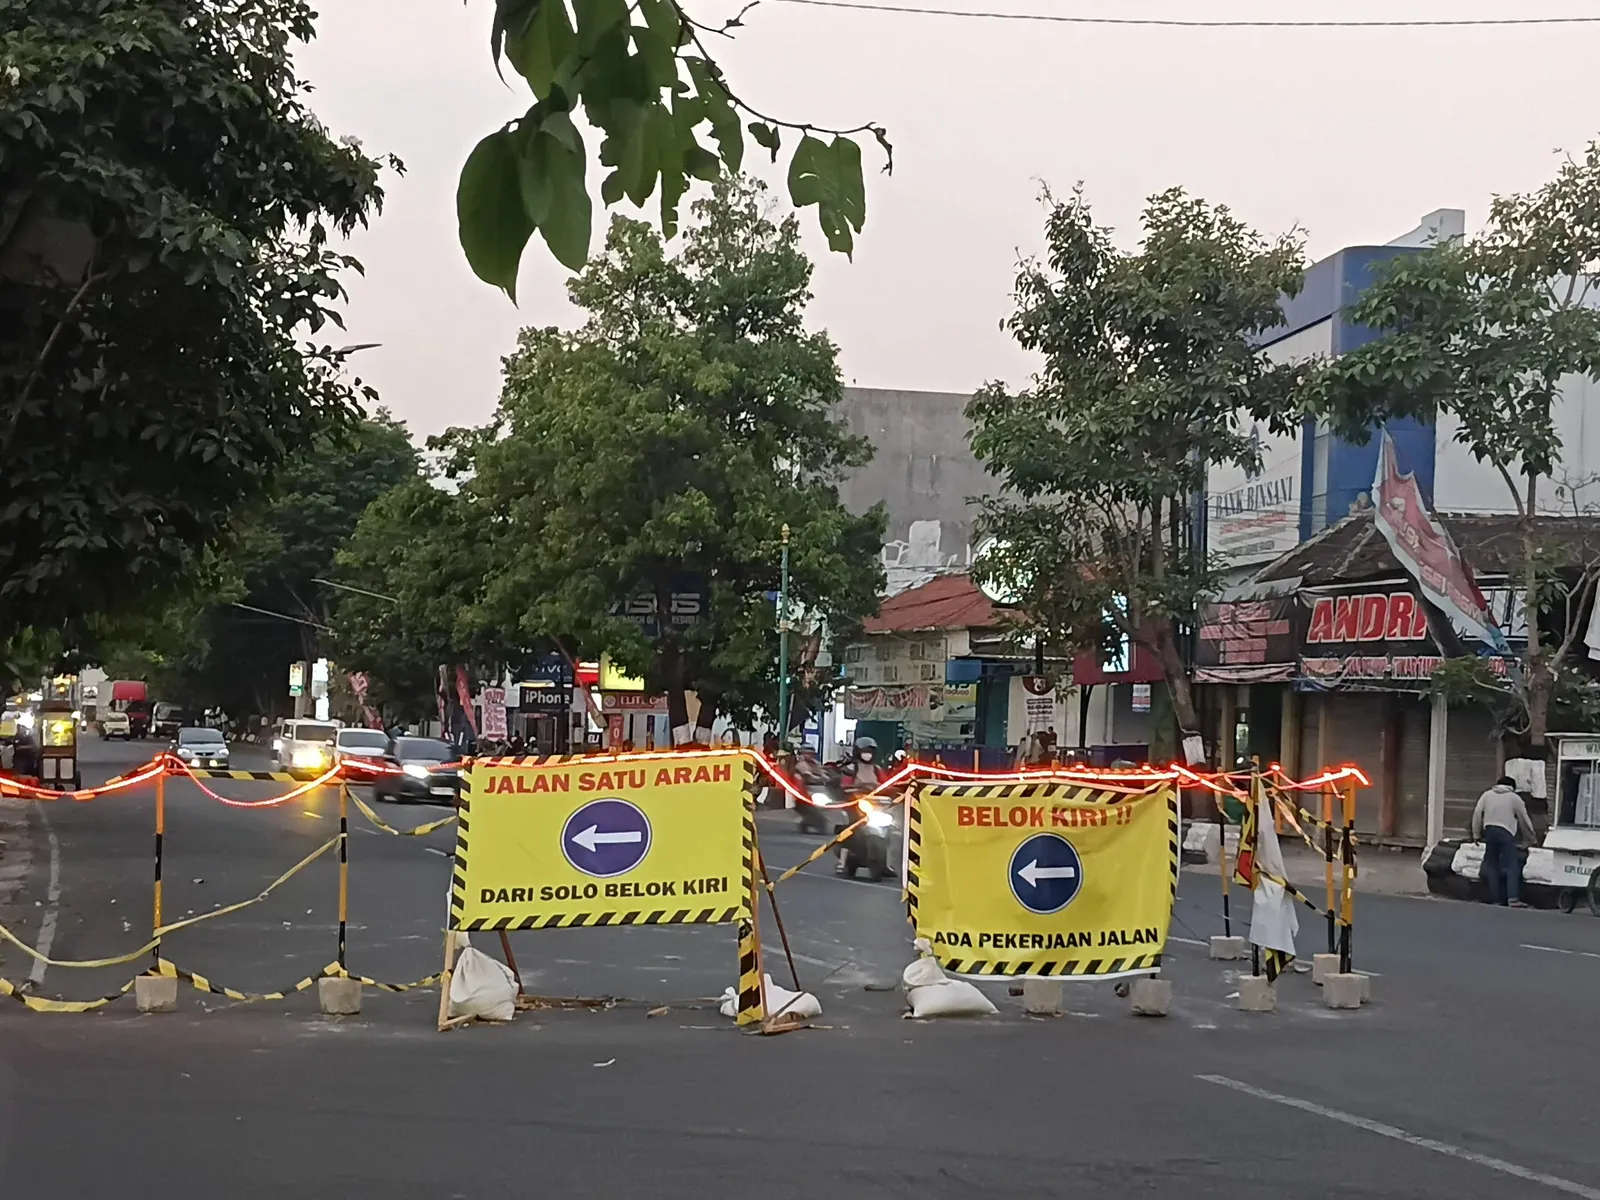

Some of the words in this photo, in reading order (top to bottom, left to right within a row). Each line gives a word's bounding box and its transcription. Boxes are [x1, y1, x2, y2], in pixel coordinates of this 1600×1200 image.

[525, 690, 571, 705] iPhone
[484, 773, 570, 794] JALAN
[578, 769, 646, 791] SATU
[654, 764, 731, 787] ARAH
[957, 805, 1045, 827] BELOK
[1051, 806, 1108, 827] KIRI
[1116, 805, 1133, 825] !!
[480, 887, 533, 904] DARI
[540, 883, 598, 901] SOLO
[605, 881, 676, 897] BELOK
[683, 877, 729, 895] KIRI
[934, 931, 972, 947] ADA
[978, 931, 1092, 949] PEKERJAAN
[1097, 927, 1159, 947] JALAN
